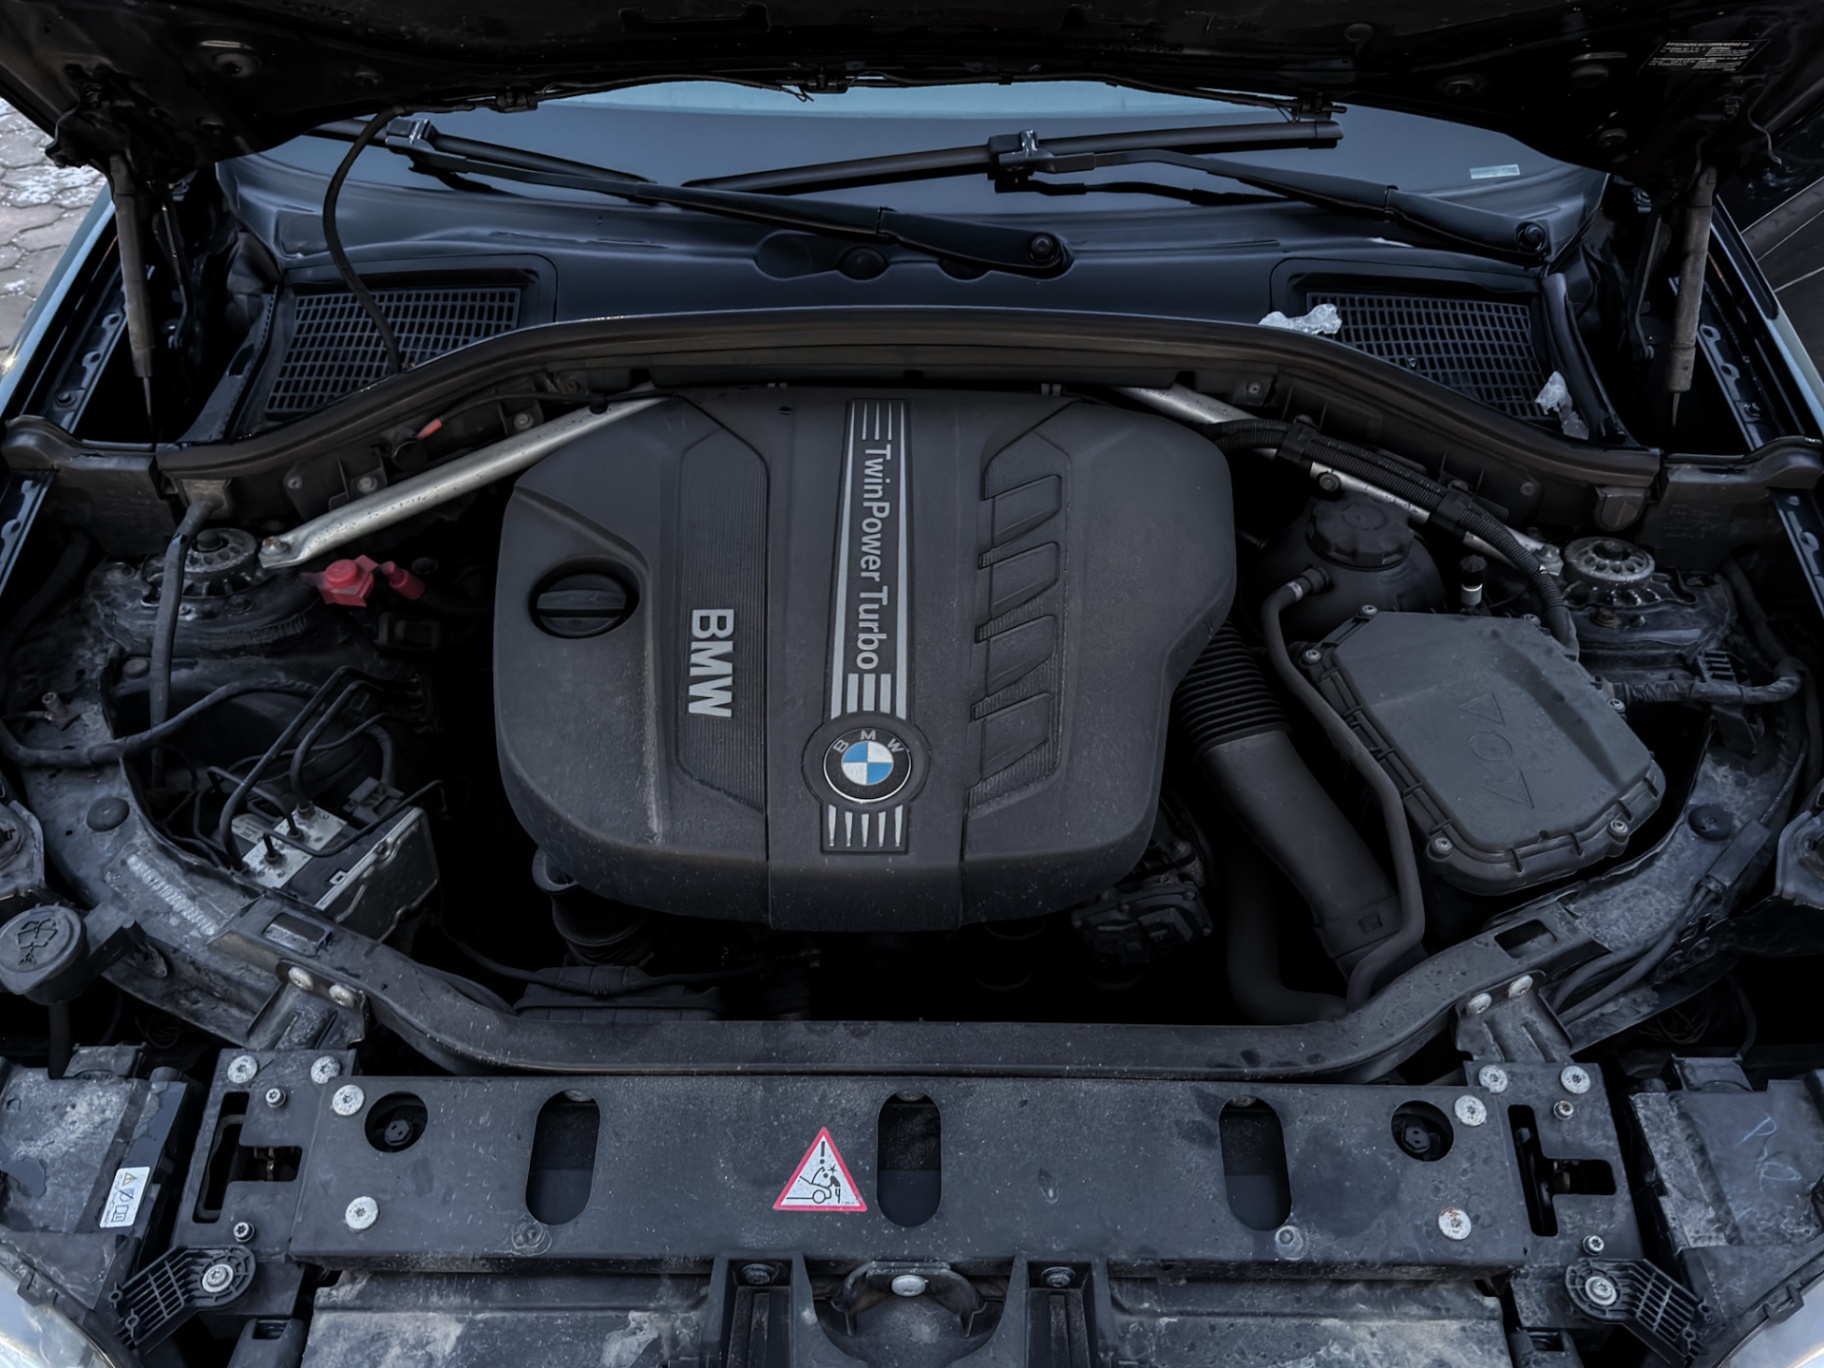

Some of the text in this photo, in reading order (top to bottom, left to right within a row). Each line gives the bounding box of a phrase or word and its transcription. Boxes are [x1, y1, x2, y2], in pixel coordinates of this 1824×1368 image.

[856, 444, 892, 670] TwinPower Turbo
[688, 608, 734, 718] BMW
[832, 729, 904, 754] BMW
